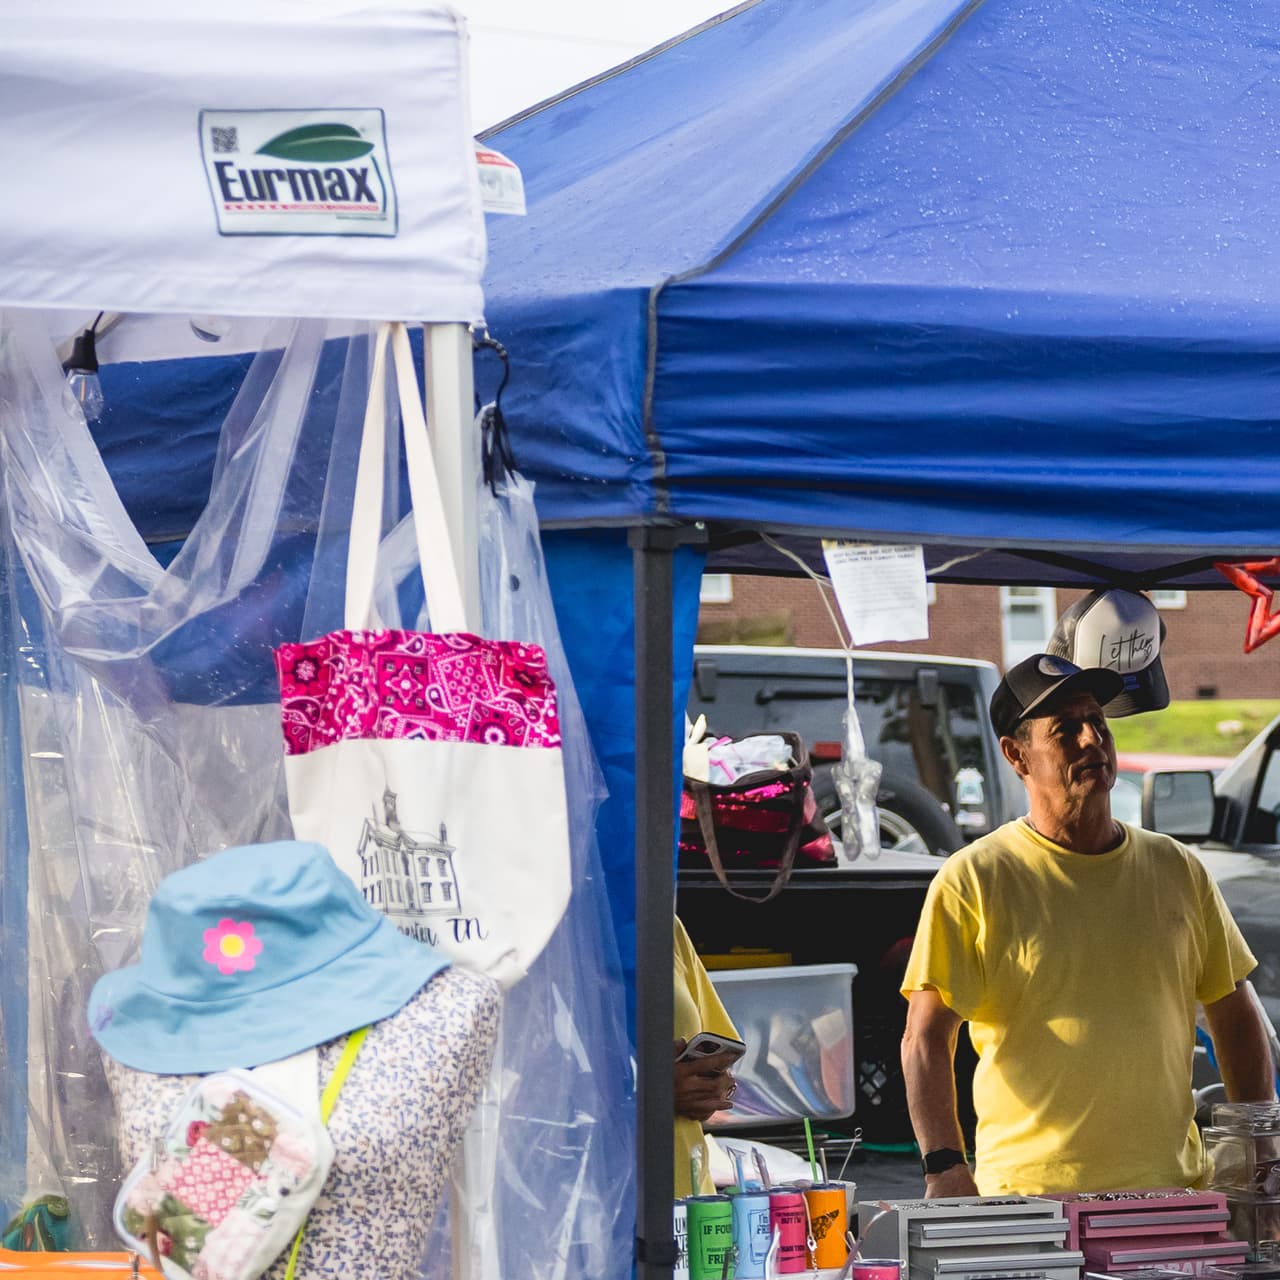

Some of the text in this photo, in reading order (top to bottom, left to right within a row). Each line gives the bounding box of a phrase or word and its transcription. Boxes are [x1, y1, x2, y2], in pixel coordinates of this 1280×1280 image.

[213, 160, 377, 203] Eurmax
[703, 1224, 713, 1235] IF
[708, 1254, 724, 1265] FRI
